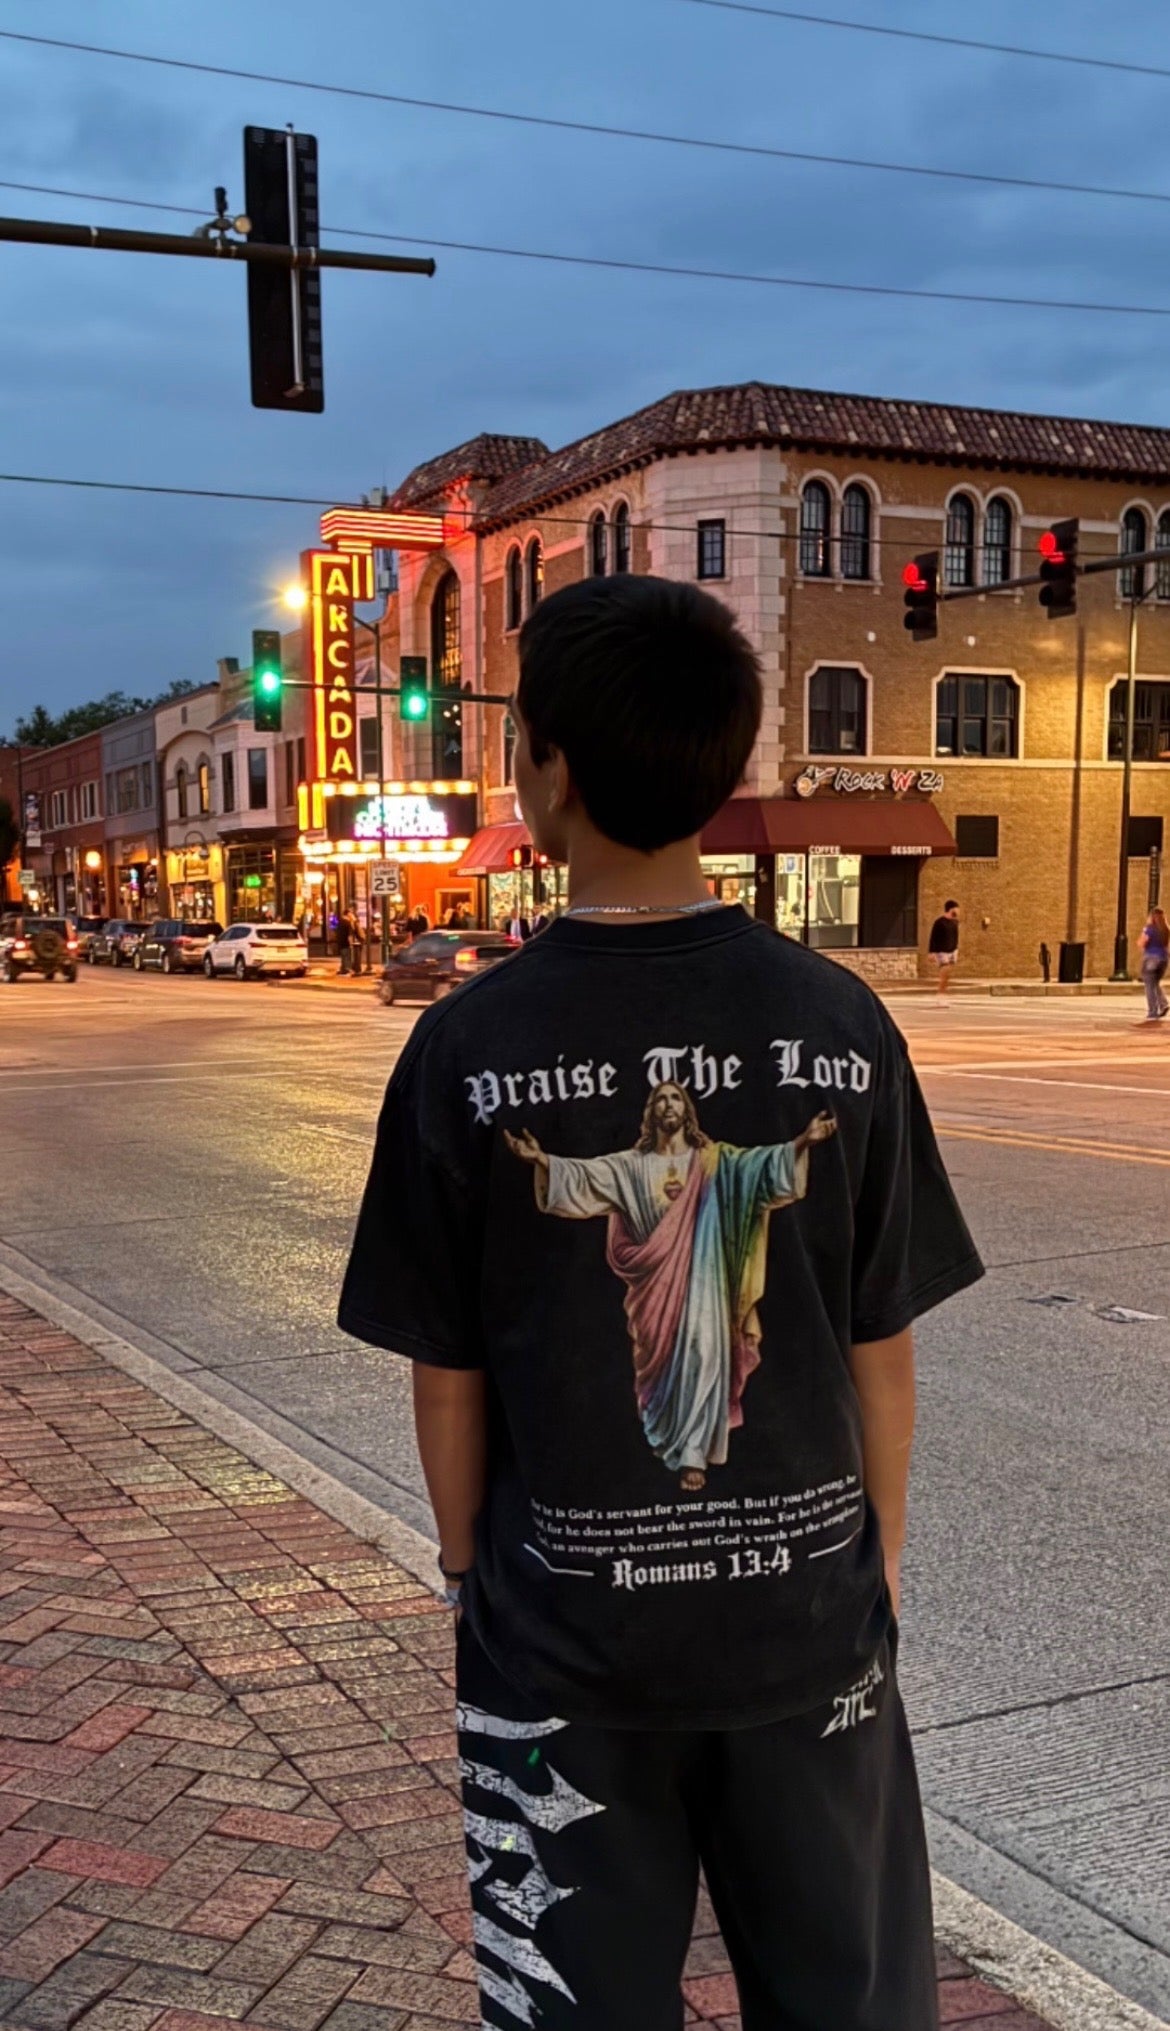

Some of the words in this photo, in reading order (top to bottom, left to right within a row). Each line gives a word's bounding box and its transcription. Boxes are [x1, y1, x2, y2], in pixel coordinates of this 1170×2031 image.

[326, 568, 354, 774] ARCADA
[809, 845, 841, 855] COFFEE
[891, 846, 932, 855] DESSERTS
[374, 877, 397, 892] 25
[464, 1054, 618, 1126] Praise
[642, 1043, 743, 1099] The
[769, 1038, 872, 1094] Lord
[555, 1507, 566, 1518] is
[568, 1508, 603, 1520] God's
[606, 1506, 653, 1519] servant
[655, 1503, 673, 1516] for
[676, 1501, 703, 1516] your
[707, 1498, 741, 1514] good.
[744, 1497, 767, 1509] But
[769, 1495, 780, 1507] if
[782, 1493, 803, 1509] you
[803, 1488, 816, 1500] do
[547, 1522, 563, 1535] for
[565, 1524, 580, 1536] he
[582, 1526, 611, 1537] does
[614, 1527, 635, 1537] not
[637, 1523, 664, 1535] bear
[666, 1520, 687, 1532] the
[688, 1517, 726, 1531] sword
[729, 1516, 743, 1528] in
[745, 1515, 776, 1527] vain.
[778, 1511, 797, 1523] For
[798, 1508, 811, 1519] he
[551, 1543, 566, 1552] an
[568, 1545, 615, 1558] avenger
[618, 1542, 645, 1553] who
[647, 1538, 689, 1552] carries
[691, 1537, 711, 1547] out
[714, 1533, 751, 1546] God's
[753, 1530, 788, 1543] wrath
[790, 1527, 804, 1537] on
[612, 1557, 718, 1591] Romans
[727, 1542, 793, 1581] 13:4
